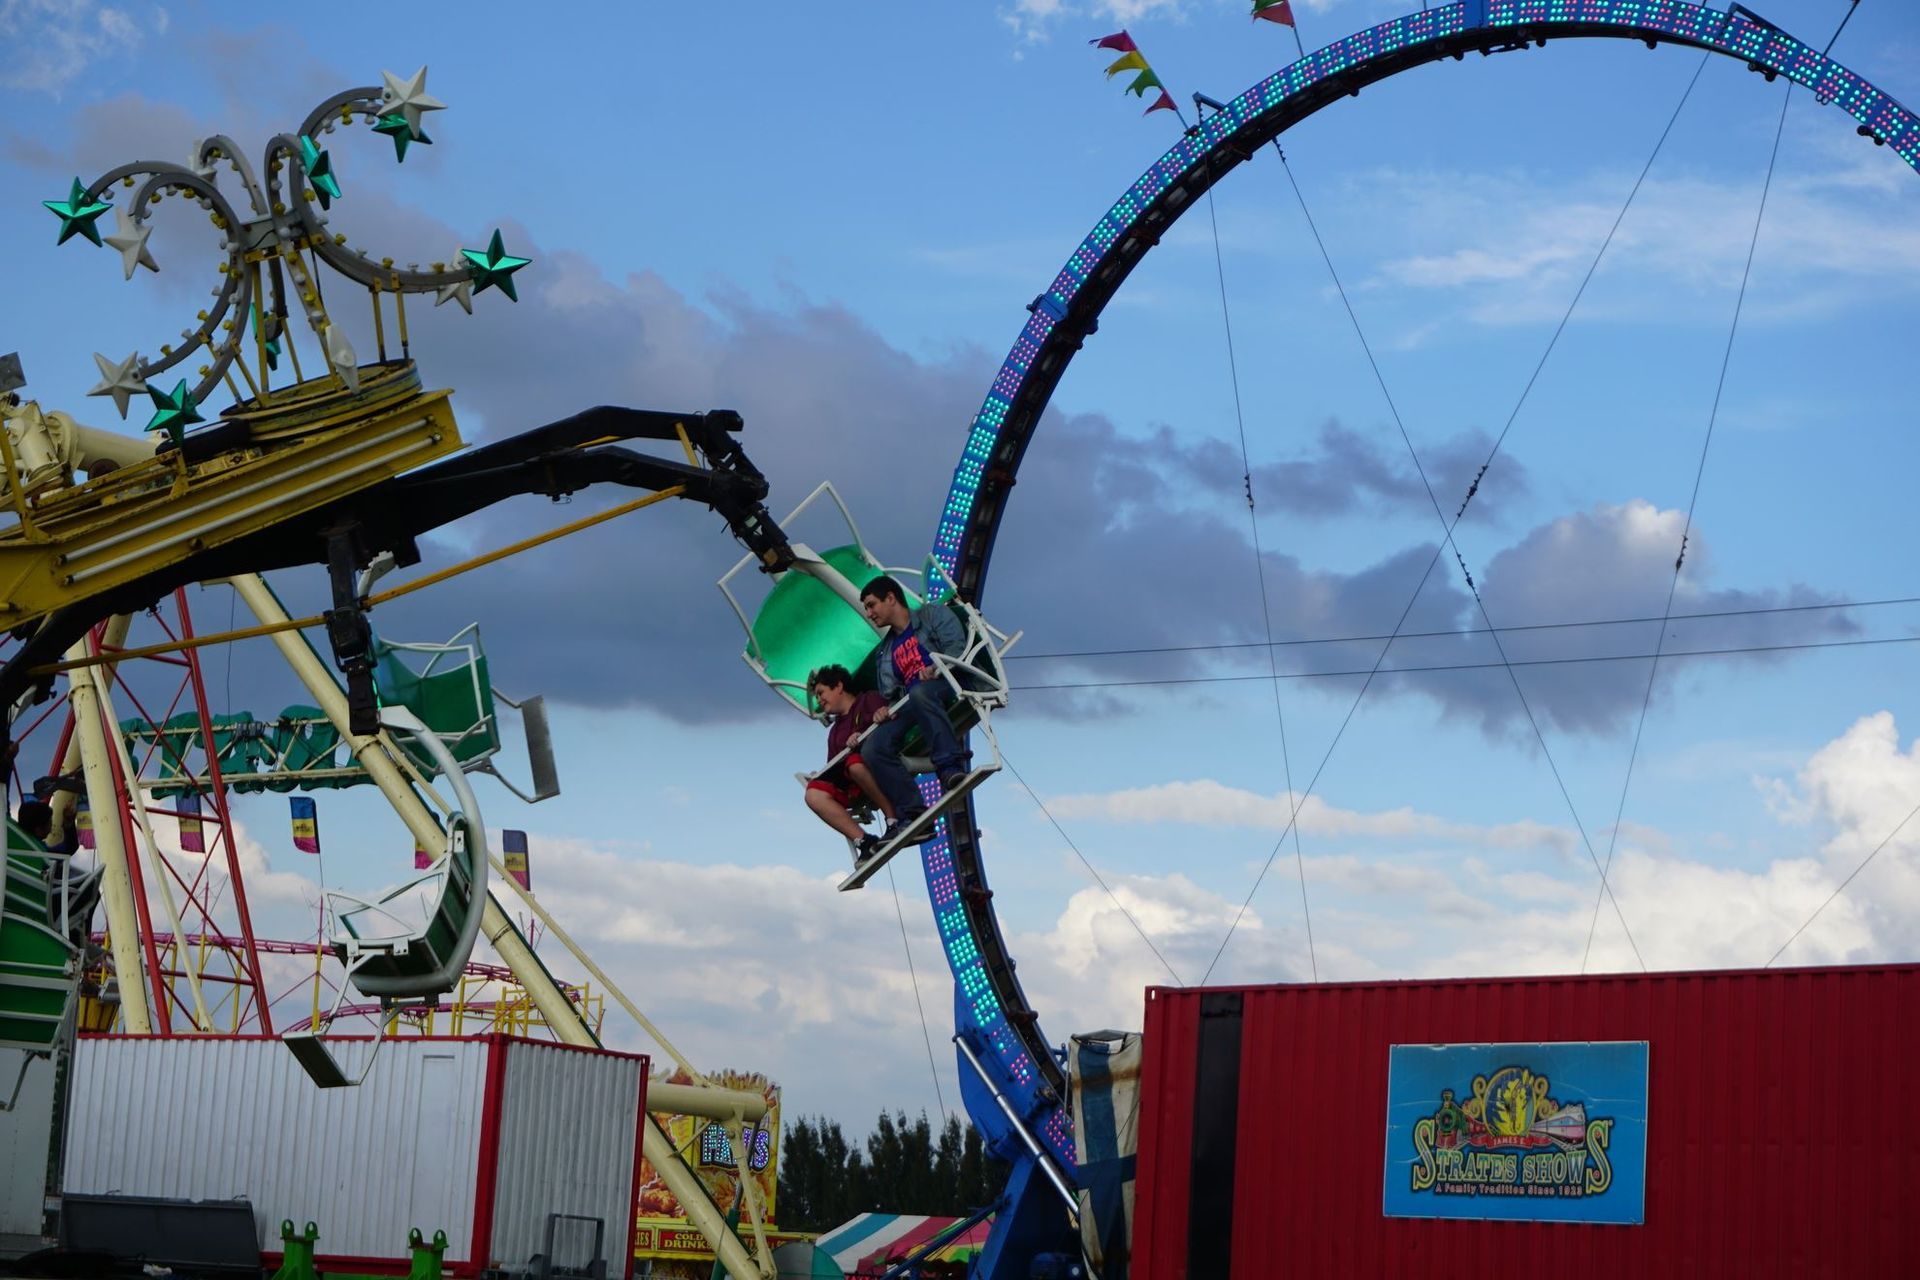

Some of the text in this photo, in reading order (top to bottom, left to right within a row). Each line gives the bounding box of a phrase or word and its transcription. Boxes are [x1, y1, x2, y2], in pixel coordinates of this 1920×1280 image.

[1413, 1119, 1611, 1193] STRATES SHOWS
[1435, 1183, 1442, 1193] A
[1445, 1183, 1476, 1195] Family
[1480, 1184, 1525, 1195] Tradition
[1528, 1185, 1555, 1195] Since
[675, 1233, 704, 1241] COLD
